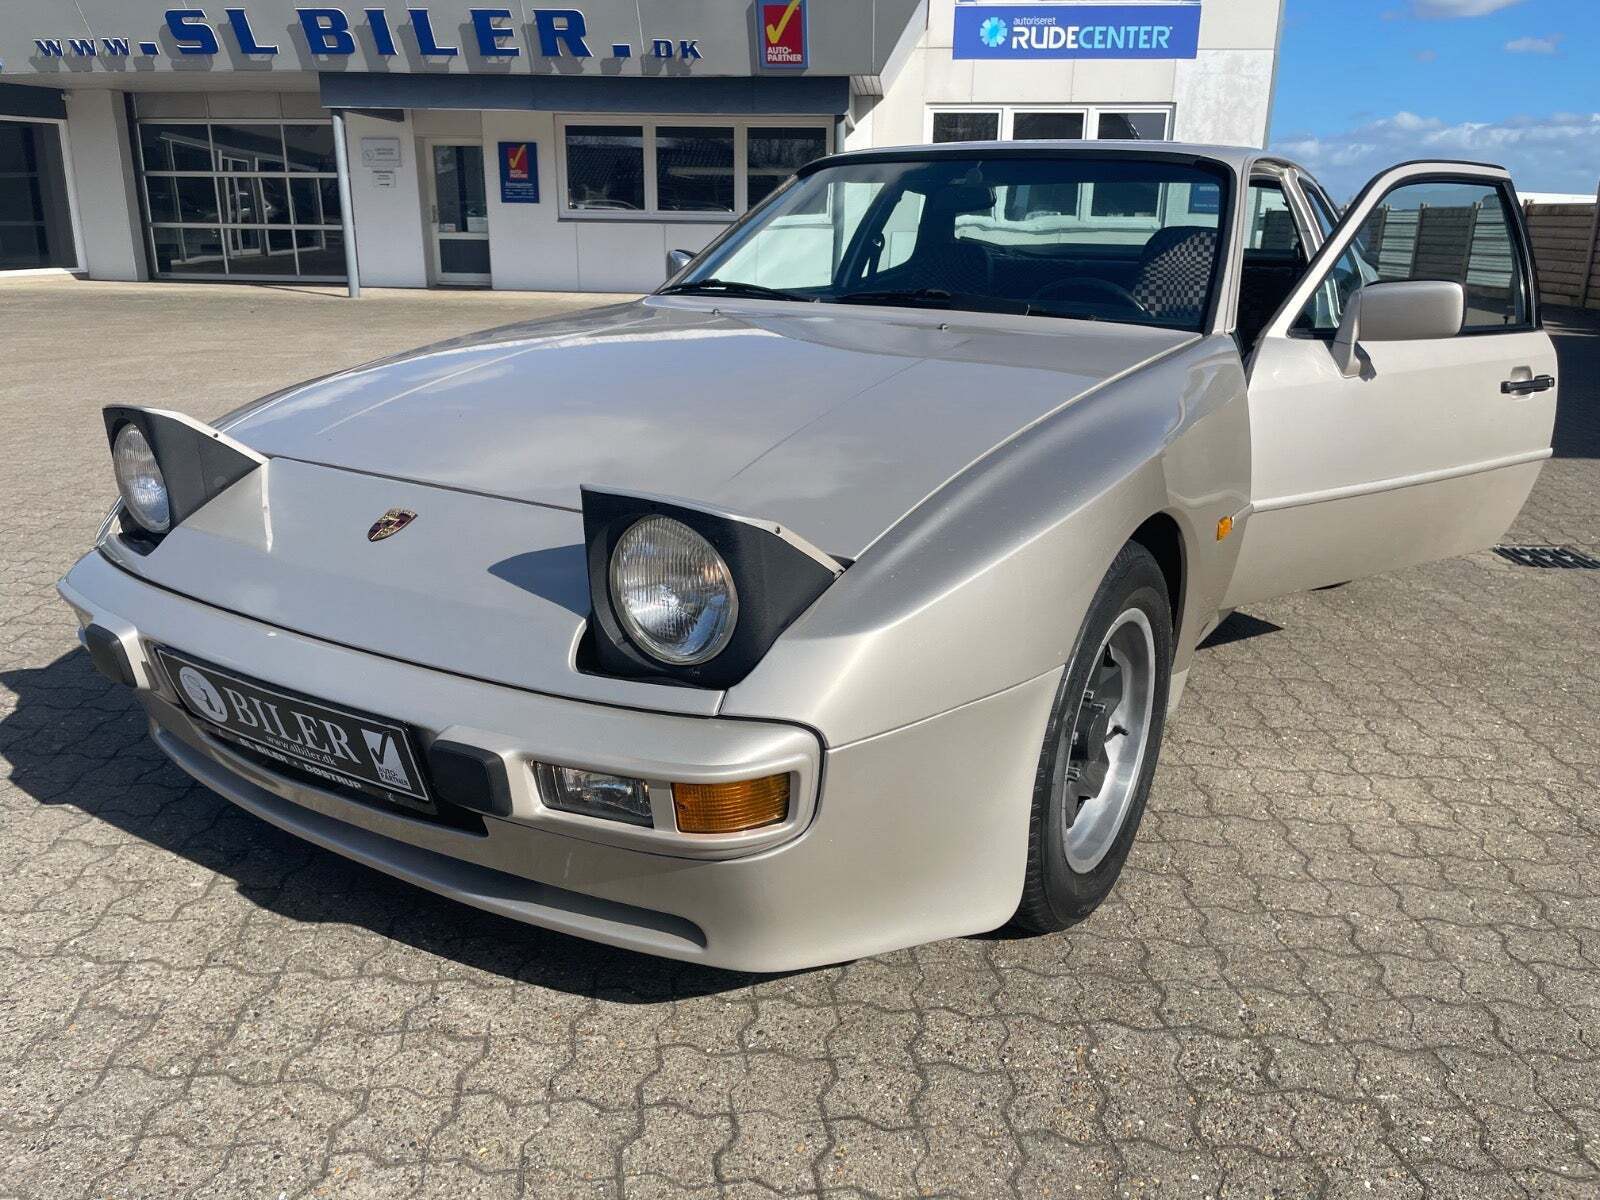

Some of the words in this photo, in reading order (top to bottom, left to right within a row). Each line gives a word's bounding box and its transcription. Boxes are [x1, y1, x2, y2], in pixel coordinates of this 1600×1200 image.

[1013, 16, 1056, 26] autoriseret
[1011, 26, 1169, 49] RUDECENTER
[767, 54, 802, 62] PARTNER
[222, 686, 361, 764] BILER
